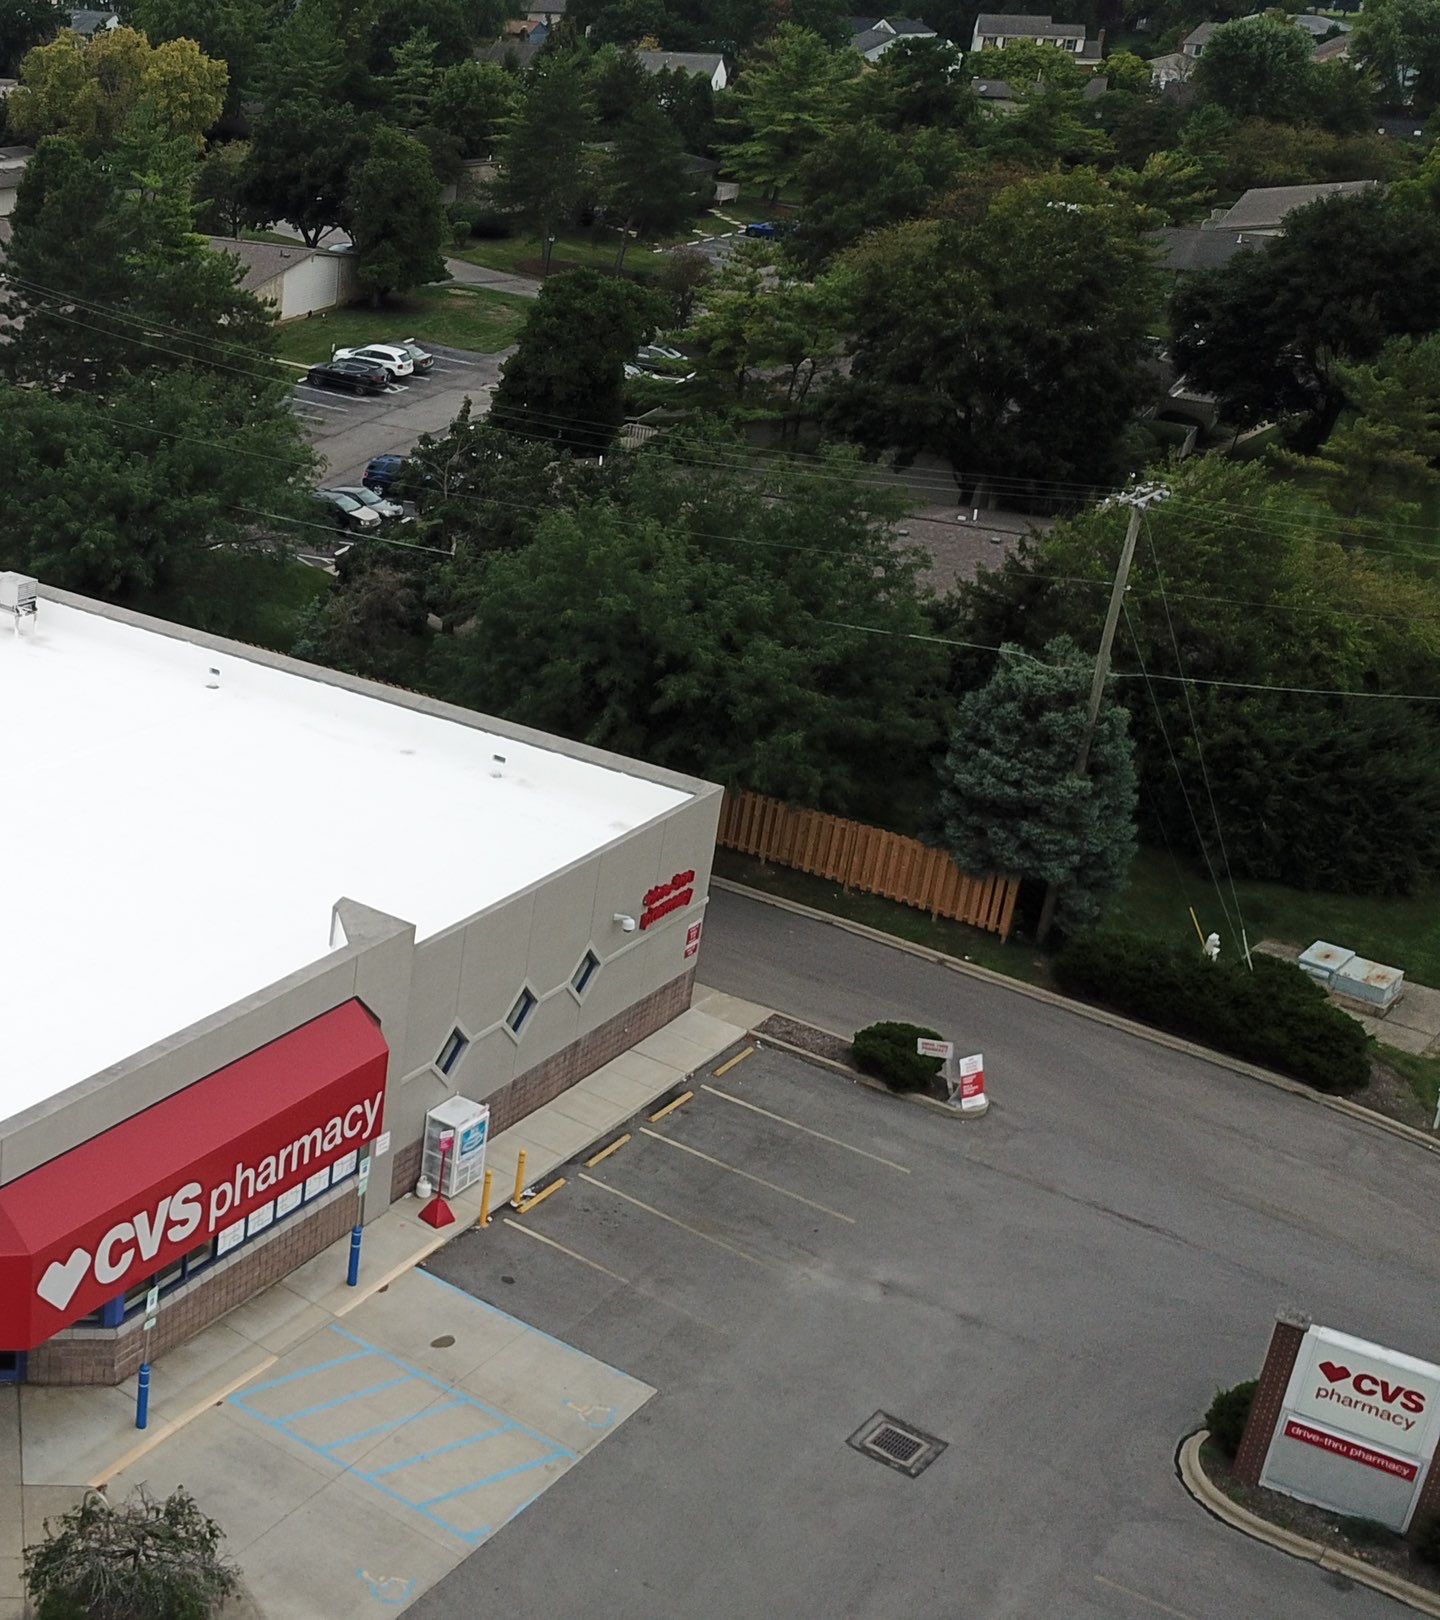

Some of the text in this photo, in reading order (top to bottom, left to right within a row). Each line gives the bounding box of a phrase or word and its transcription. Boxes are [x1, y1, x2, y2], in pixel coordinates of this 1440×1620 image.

[94, 1090, 383, 1285] CVS pharmacy
[1315, 1386, 1417, 1432] pharmacy
[1352, 1373, 1426, 1414] CVS
[1291, 1426, 1411, 1476] drive-thru pharmacy
